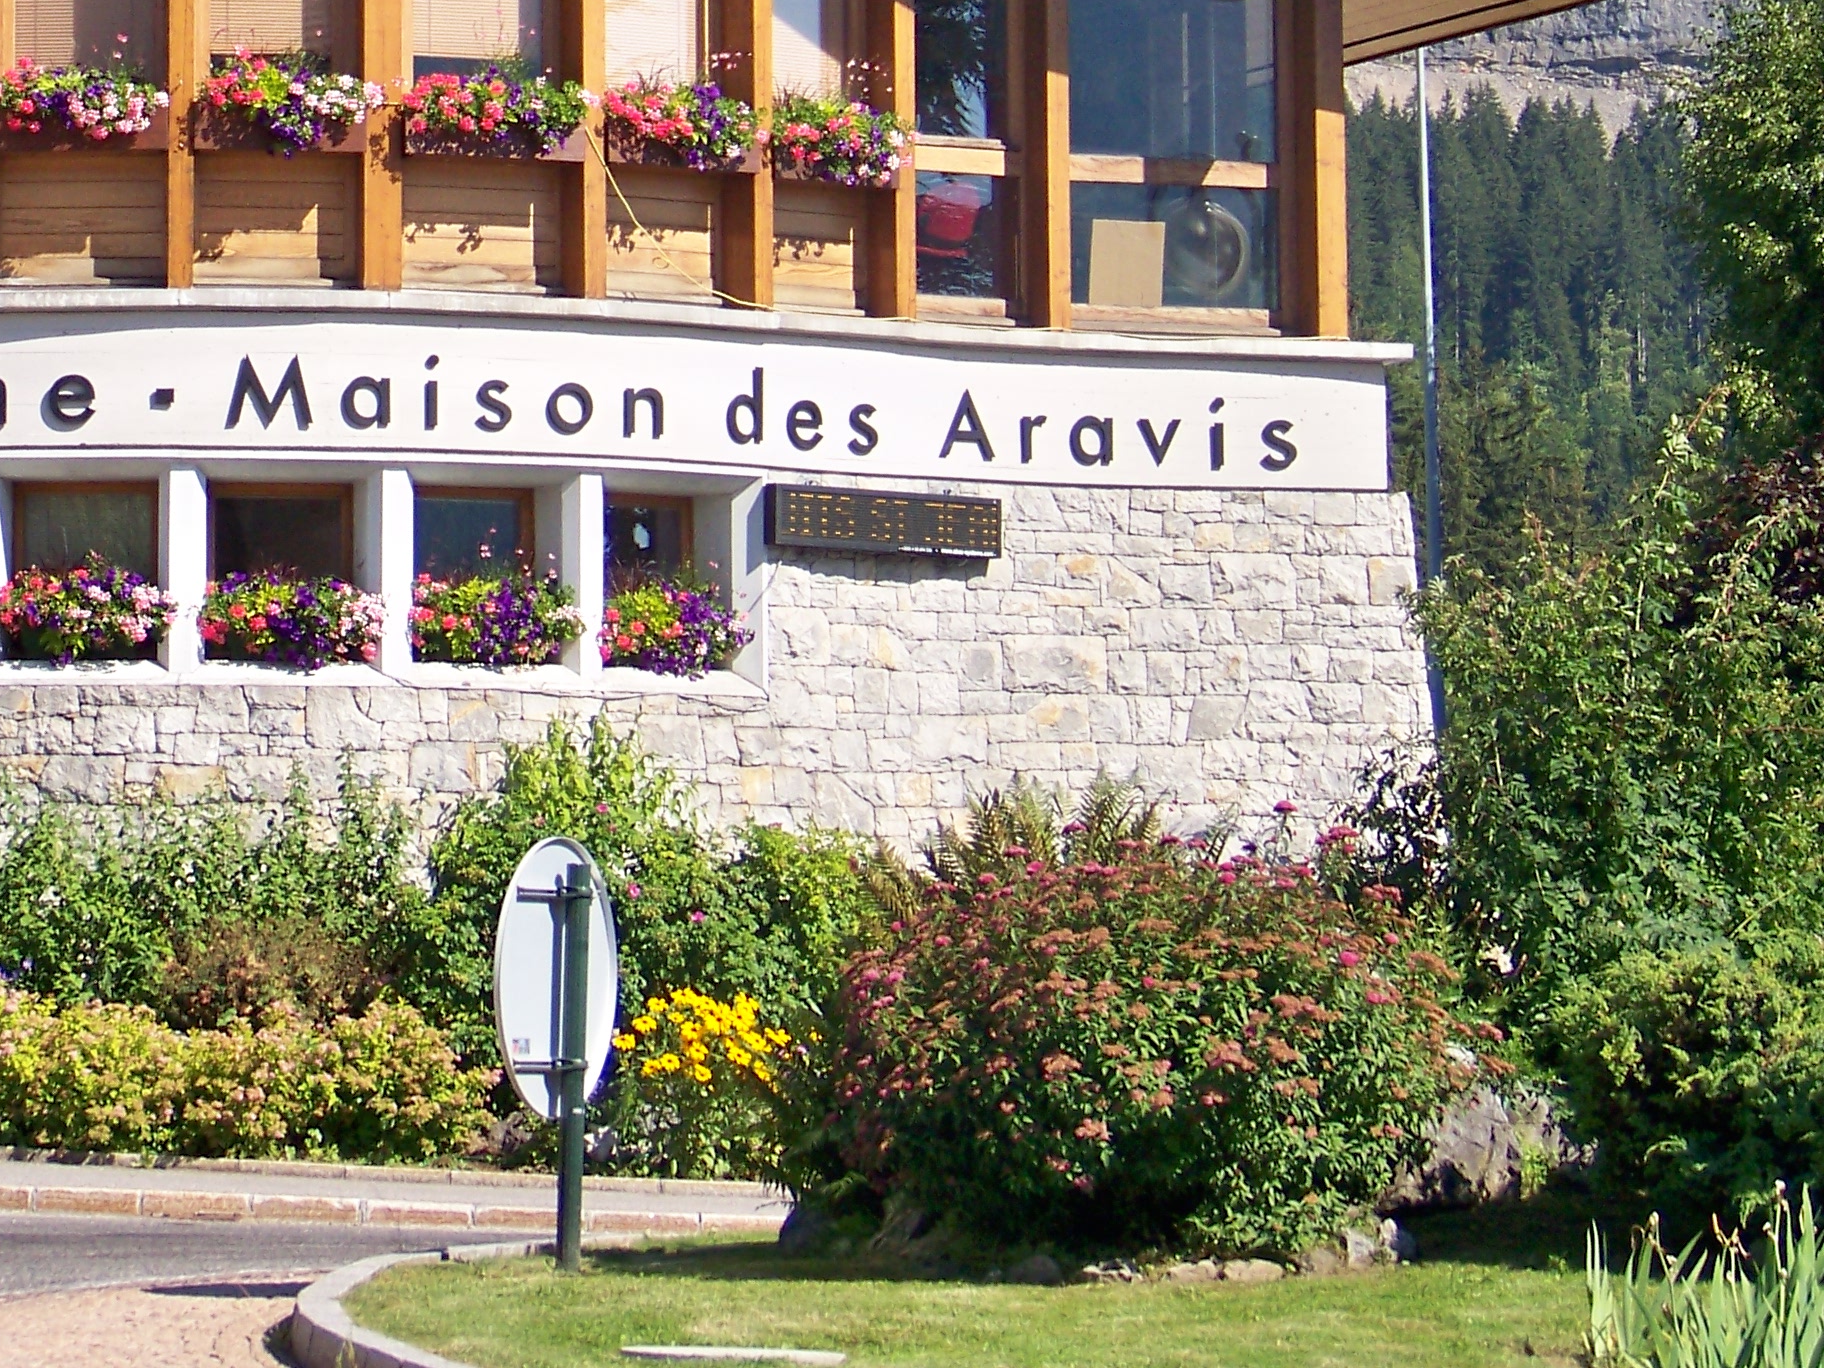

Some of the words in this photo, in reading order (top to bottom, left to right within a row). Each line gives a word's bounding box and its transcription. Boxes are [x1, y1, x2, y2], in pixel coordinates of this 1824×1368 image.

[227, 354, 664, 439] Maison
[726, 366, 881, 456] des
[940, 389, 1299, 473] Aravis
